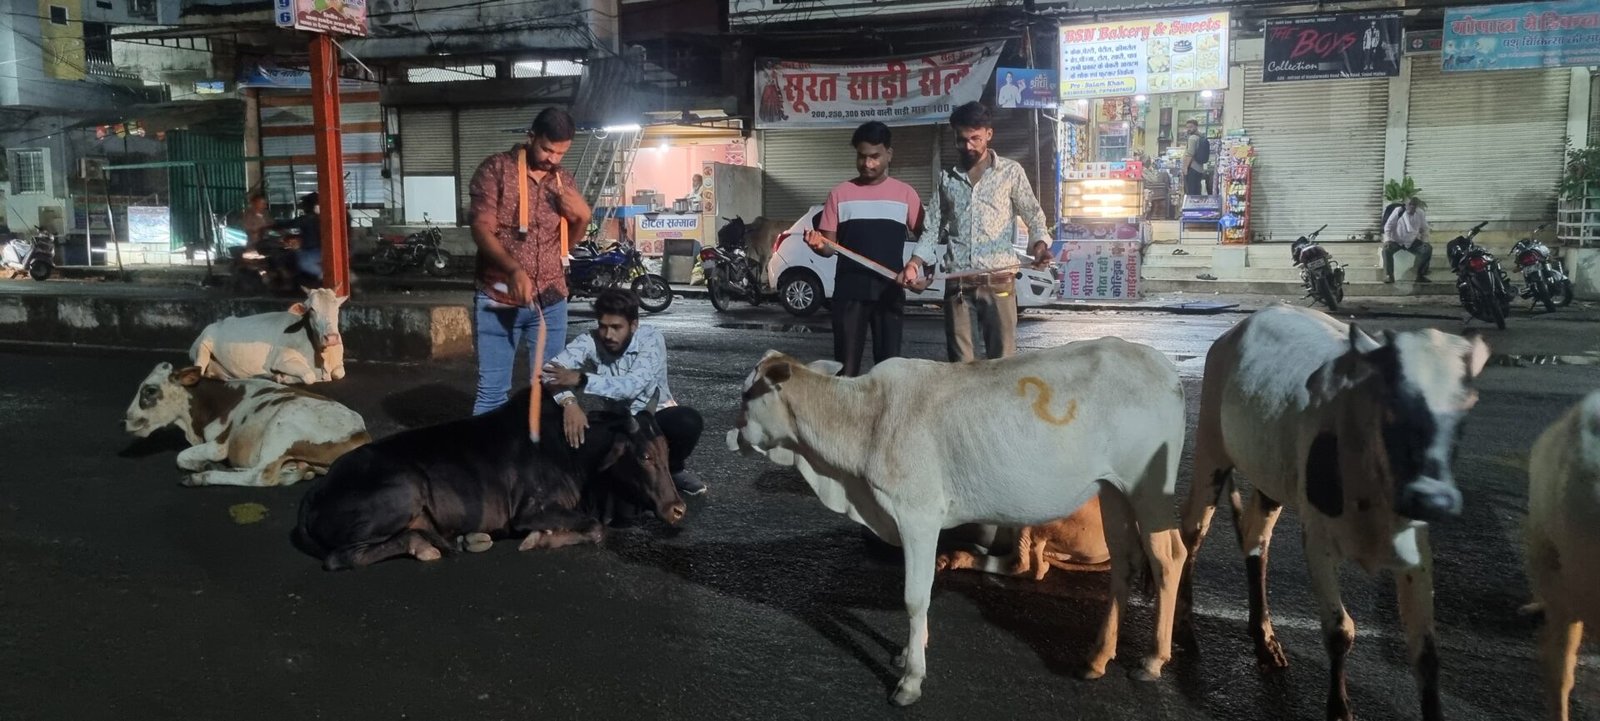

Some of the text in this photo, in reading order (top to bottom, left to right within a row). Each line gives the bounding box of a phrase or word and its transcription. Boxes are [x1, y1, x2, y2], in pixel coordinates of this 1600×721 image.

[280, 12, 291, 22] 6
[1452, 15, 1518, 35] गोपाल
[1064, 17, 1221, 43] BSN Bakery & Sweets
[1268, 60, 1318, 72] Collection
[782, 73, 839, 113] सूरत
[847, 58, 911, 106] साड़ी
[933, 104, 950, 113] 100
[666, 218, 697, 228] सम्मान
[1069, 271, 1080, 296] लस्सी
[1096, 256, 1108, 297] मीठा दही
